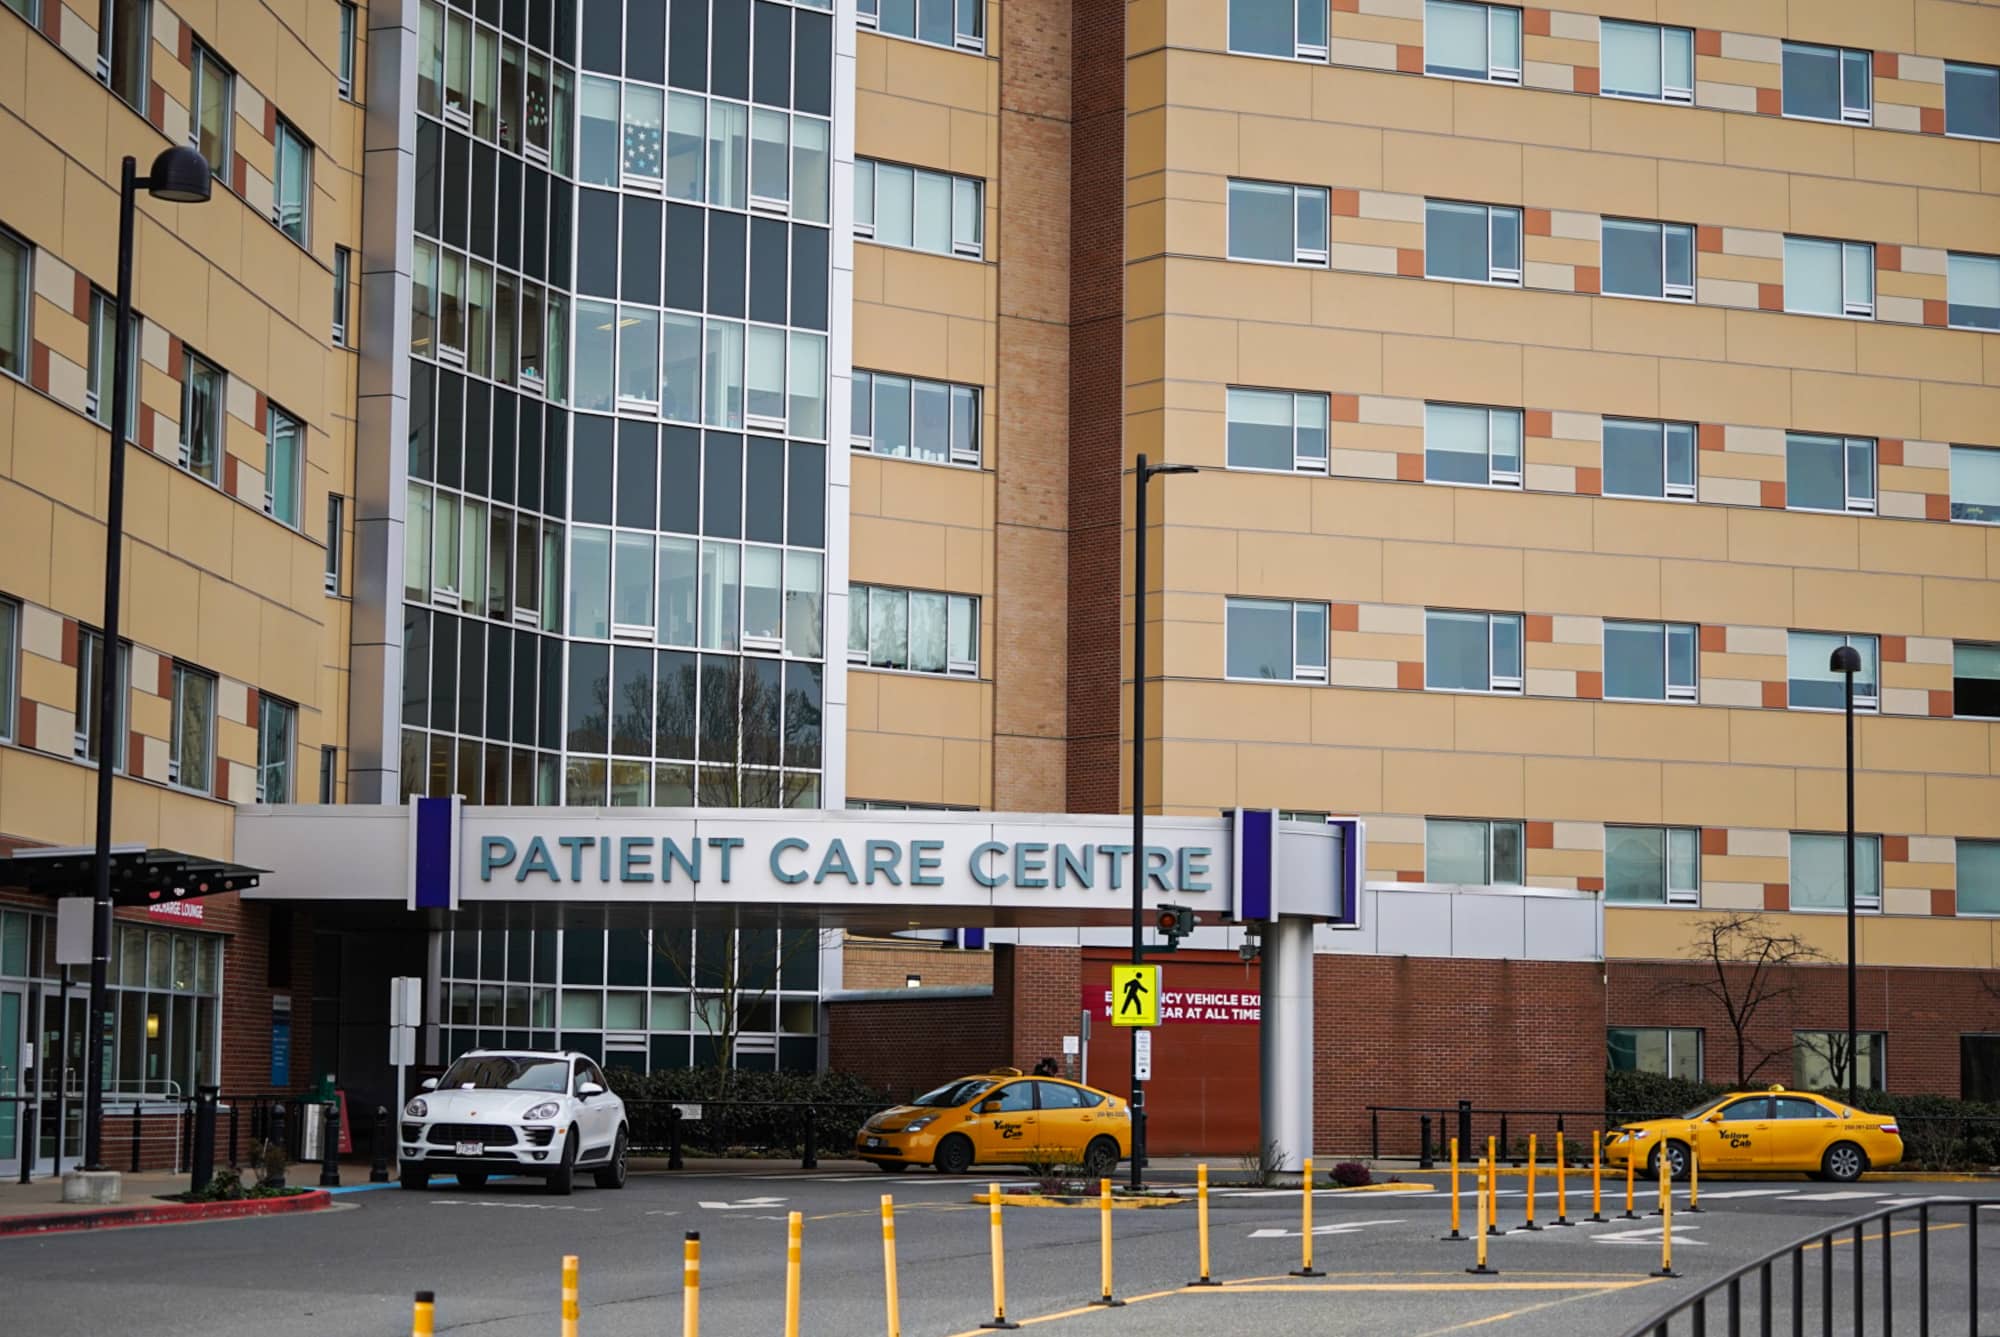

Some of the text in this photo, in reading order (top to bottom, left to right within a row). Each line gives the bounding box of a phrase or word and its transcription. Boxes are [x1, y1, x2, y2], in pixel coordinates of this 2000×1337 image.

[480, 836, 1212, 893] PATIENT CARE CENTRE
[181, 902, 203, 919] LOUNGE
[1185, 993, 1239, 1006] VEHICLE
[1241, 994, 1261, 1007] EXI
[1160, 1007, 1261, 1020] EAR AT ALL TIME
[1719, 1130, 1749, 1139] Yellow
[1730, 1139, 1752, 1148] Cab
